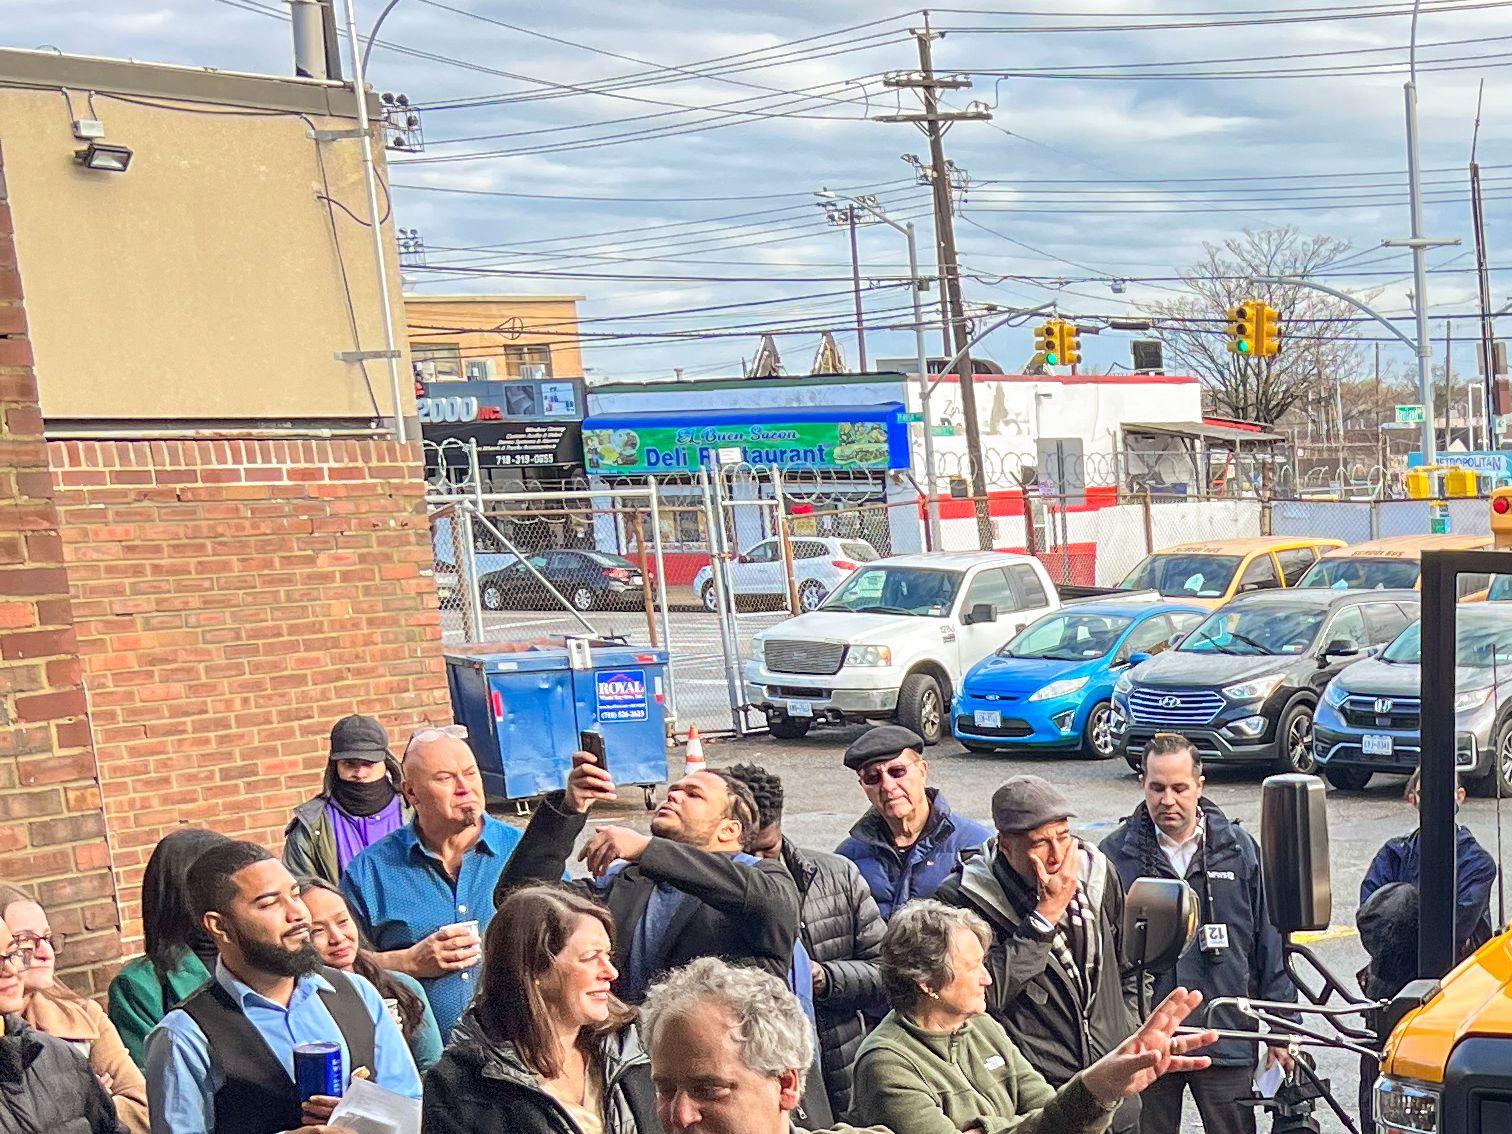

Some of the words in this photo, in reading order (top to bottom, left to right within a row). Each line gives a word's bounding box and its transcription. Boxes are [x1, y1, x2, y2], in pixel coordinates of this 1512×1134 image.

[645, 447, 688, 467] Deli
[699, 444, 826, 465] Rtaurant
[1436, 456, 1501, 471] ETROPOLITAN
[598, 680, 645, 695] ROYAL
